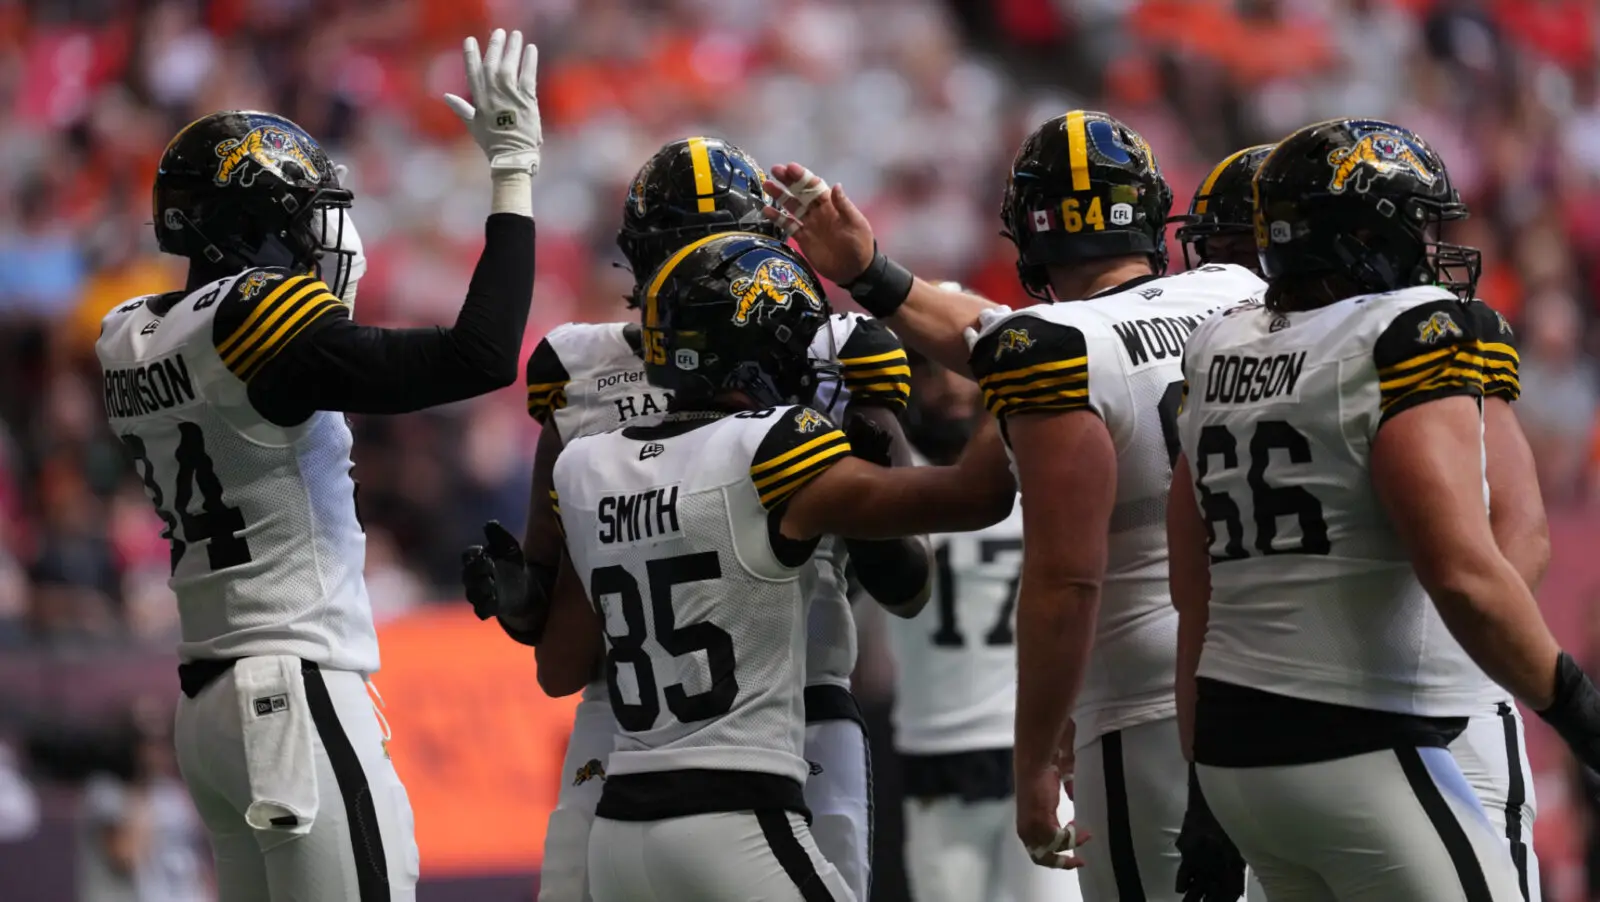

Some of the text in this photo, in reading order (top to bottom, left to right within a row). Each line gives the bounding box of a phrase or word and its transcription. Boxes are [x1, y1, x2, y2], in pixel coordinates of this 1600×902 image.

[497, 115, 514, 126] CFL
[1062, 196, 1105, 233] 64
[1113, 210, 1129, 220] CFL
[104, 353, 196, 419] ROBINSON
[597, 371, 646, 391] porter
[677, 354, 695, 366] CFL
[1204, 350, 1307, 403] DOBSON
[598, 486, 680, 543] SMITH
[1196, 420, 1331, 563] 66
[929, 538, 1023, 647] 17
[590, 550, 739, 732] 85
